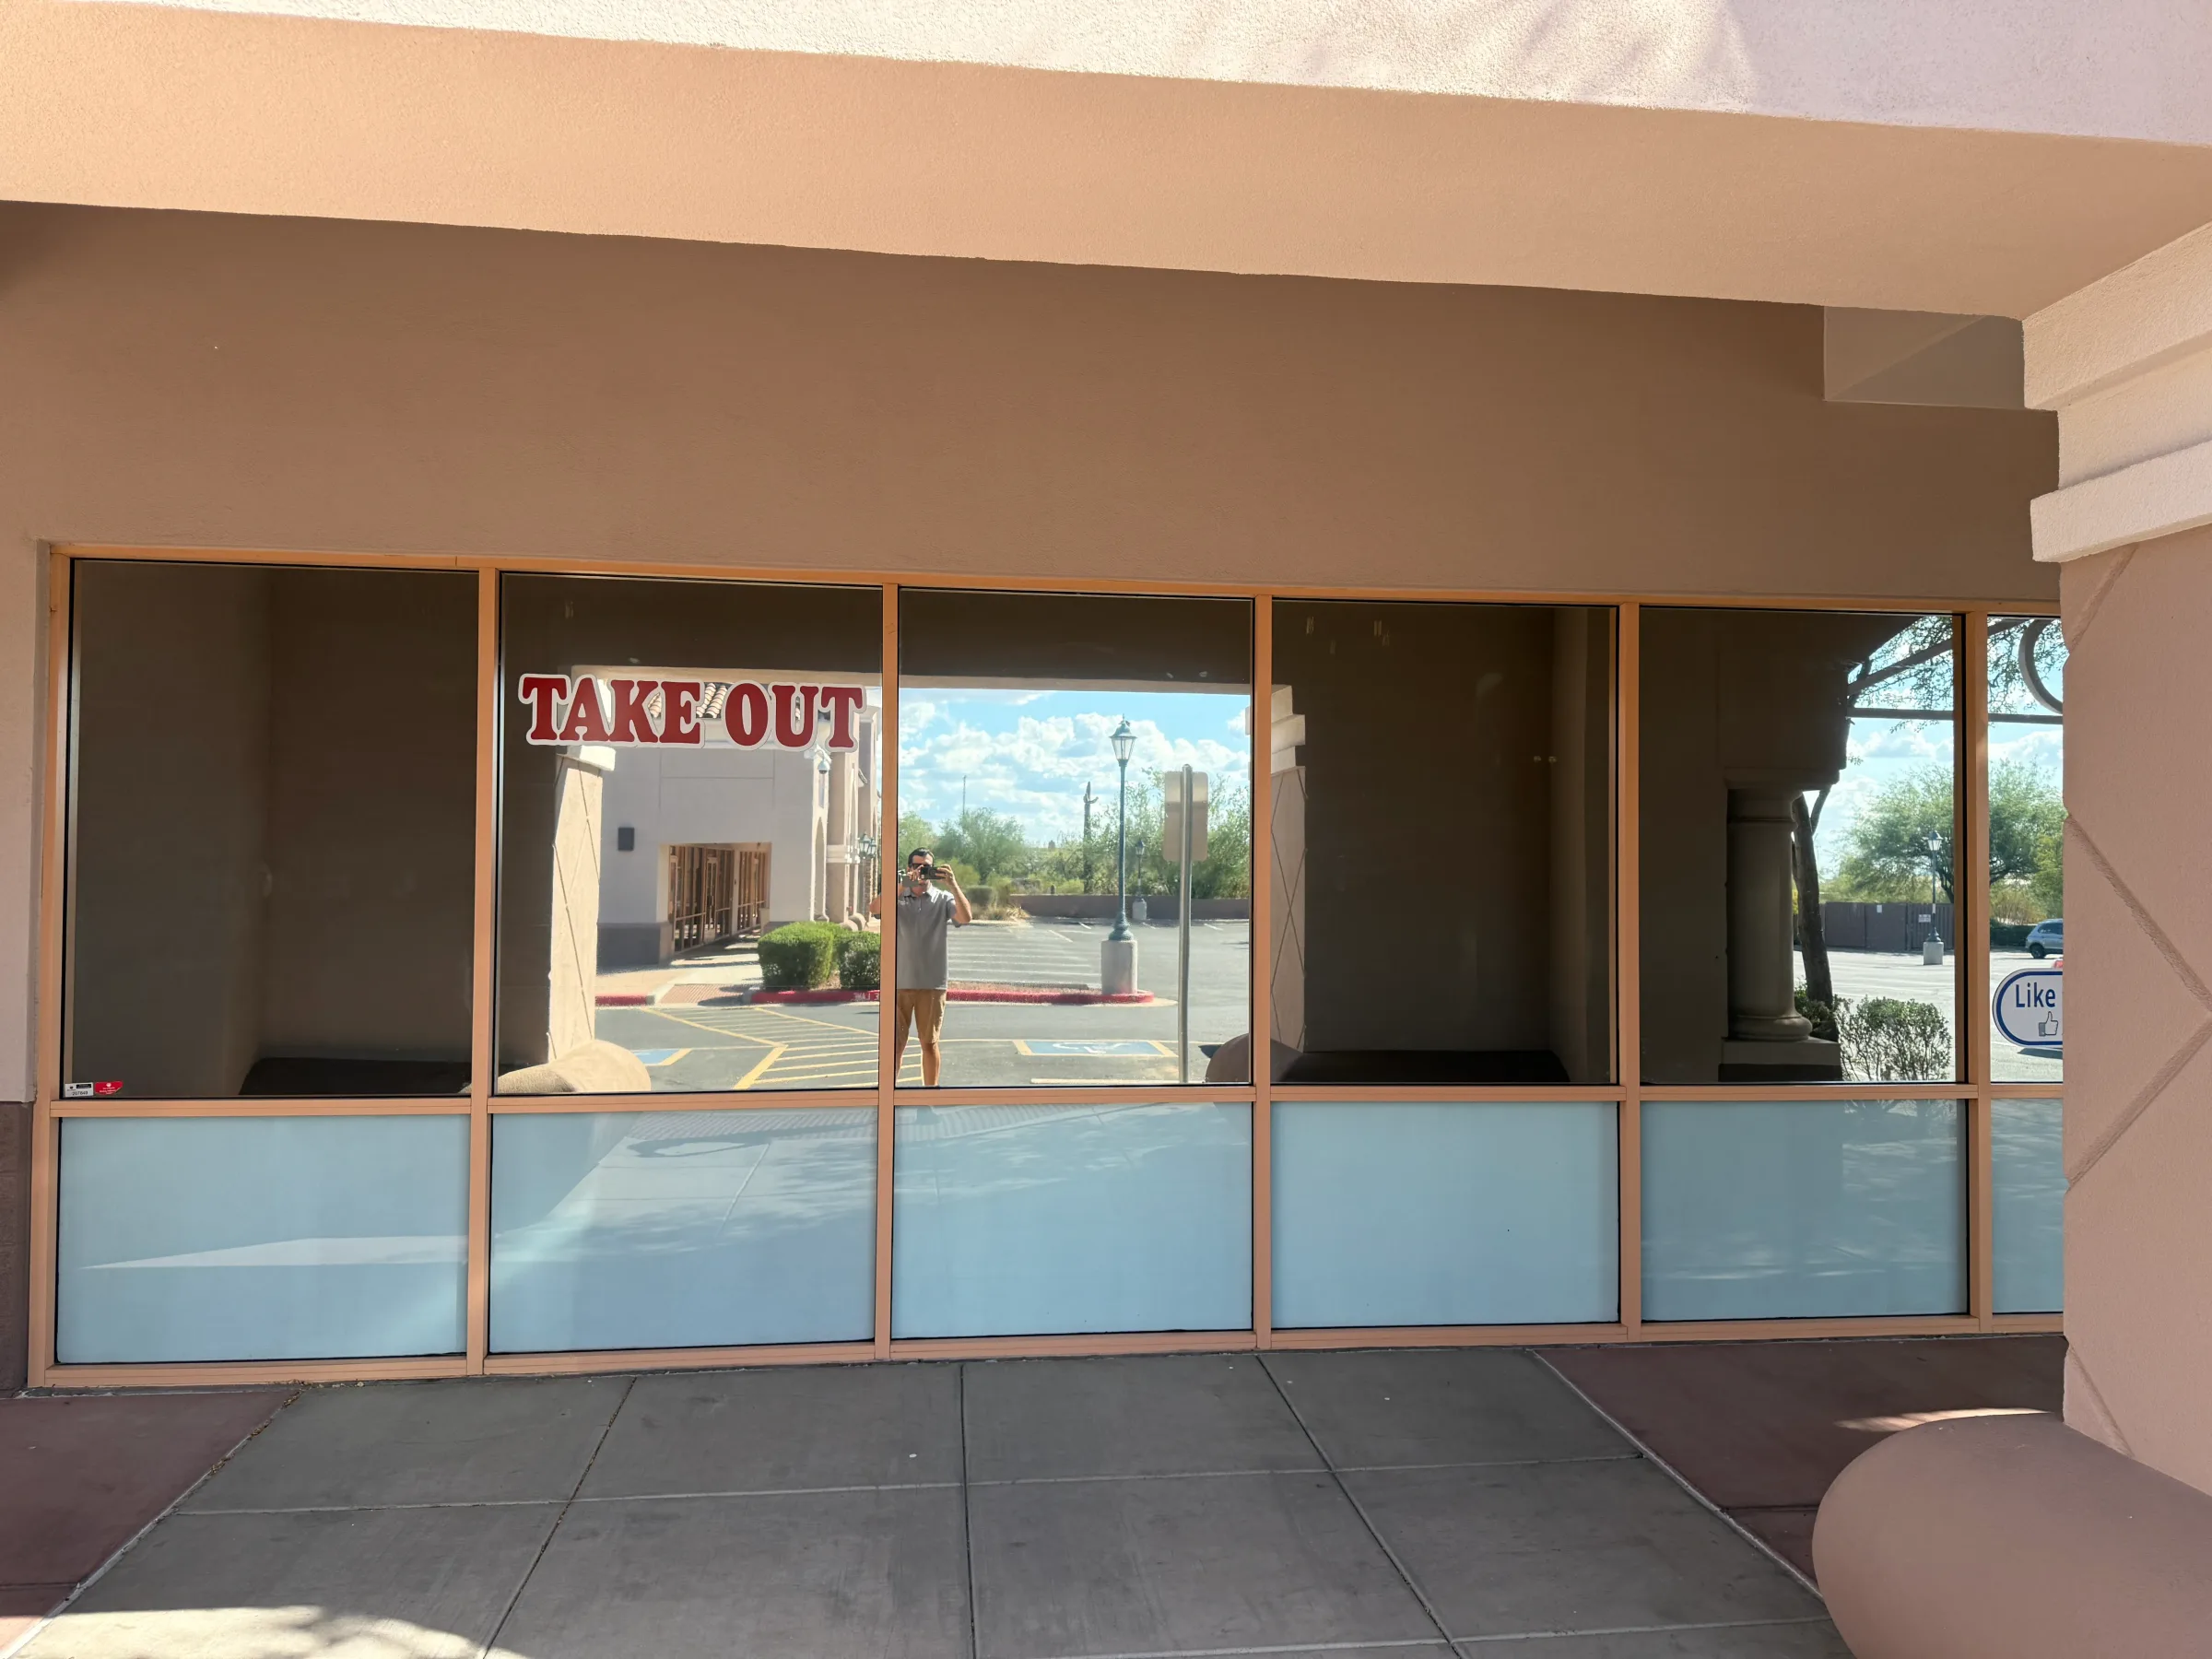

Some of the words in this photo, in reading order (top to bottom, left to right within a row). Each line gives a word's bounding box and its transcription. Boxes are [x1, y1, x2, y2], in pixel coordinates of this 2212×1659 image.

[520, 675, 706, 747] TAKE
[724, 680, 868, 751] OUT
[2015, 982, 2056, 1008] Like
